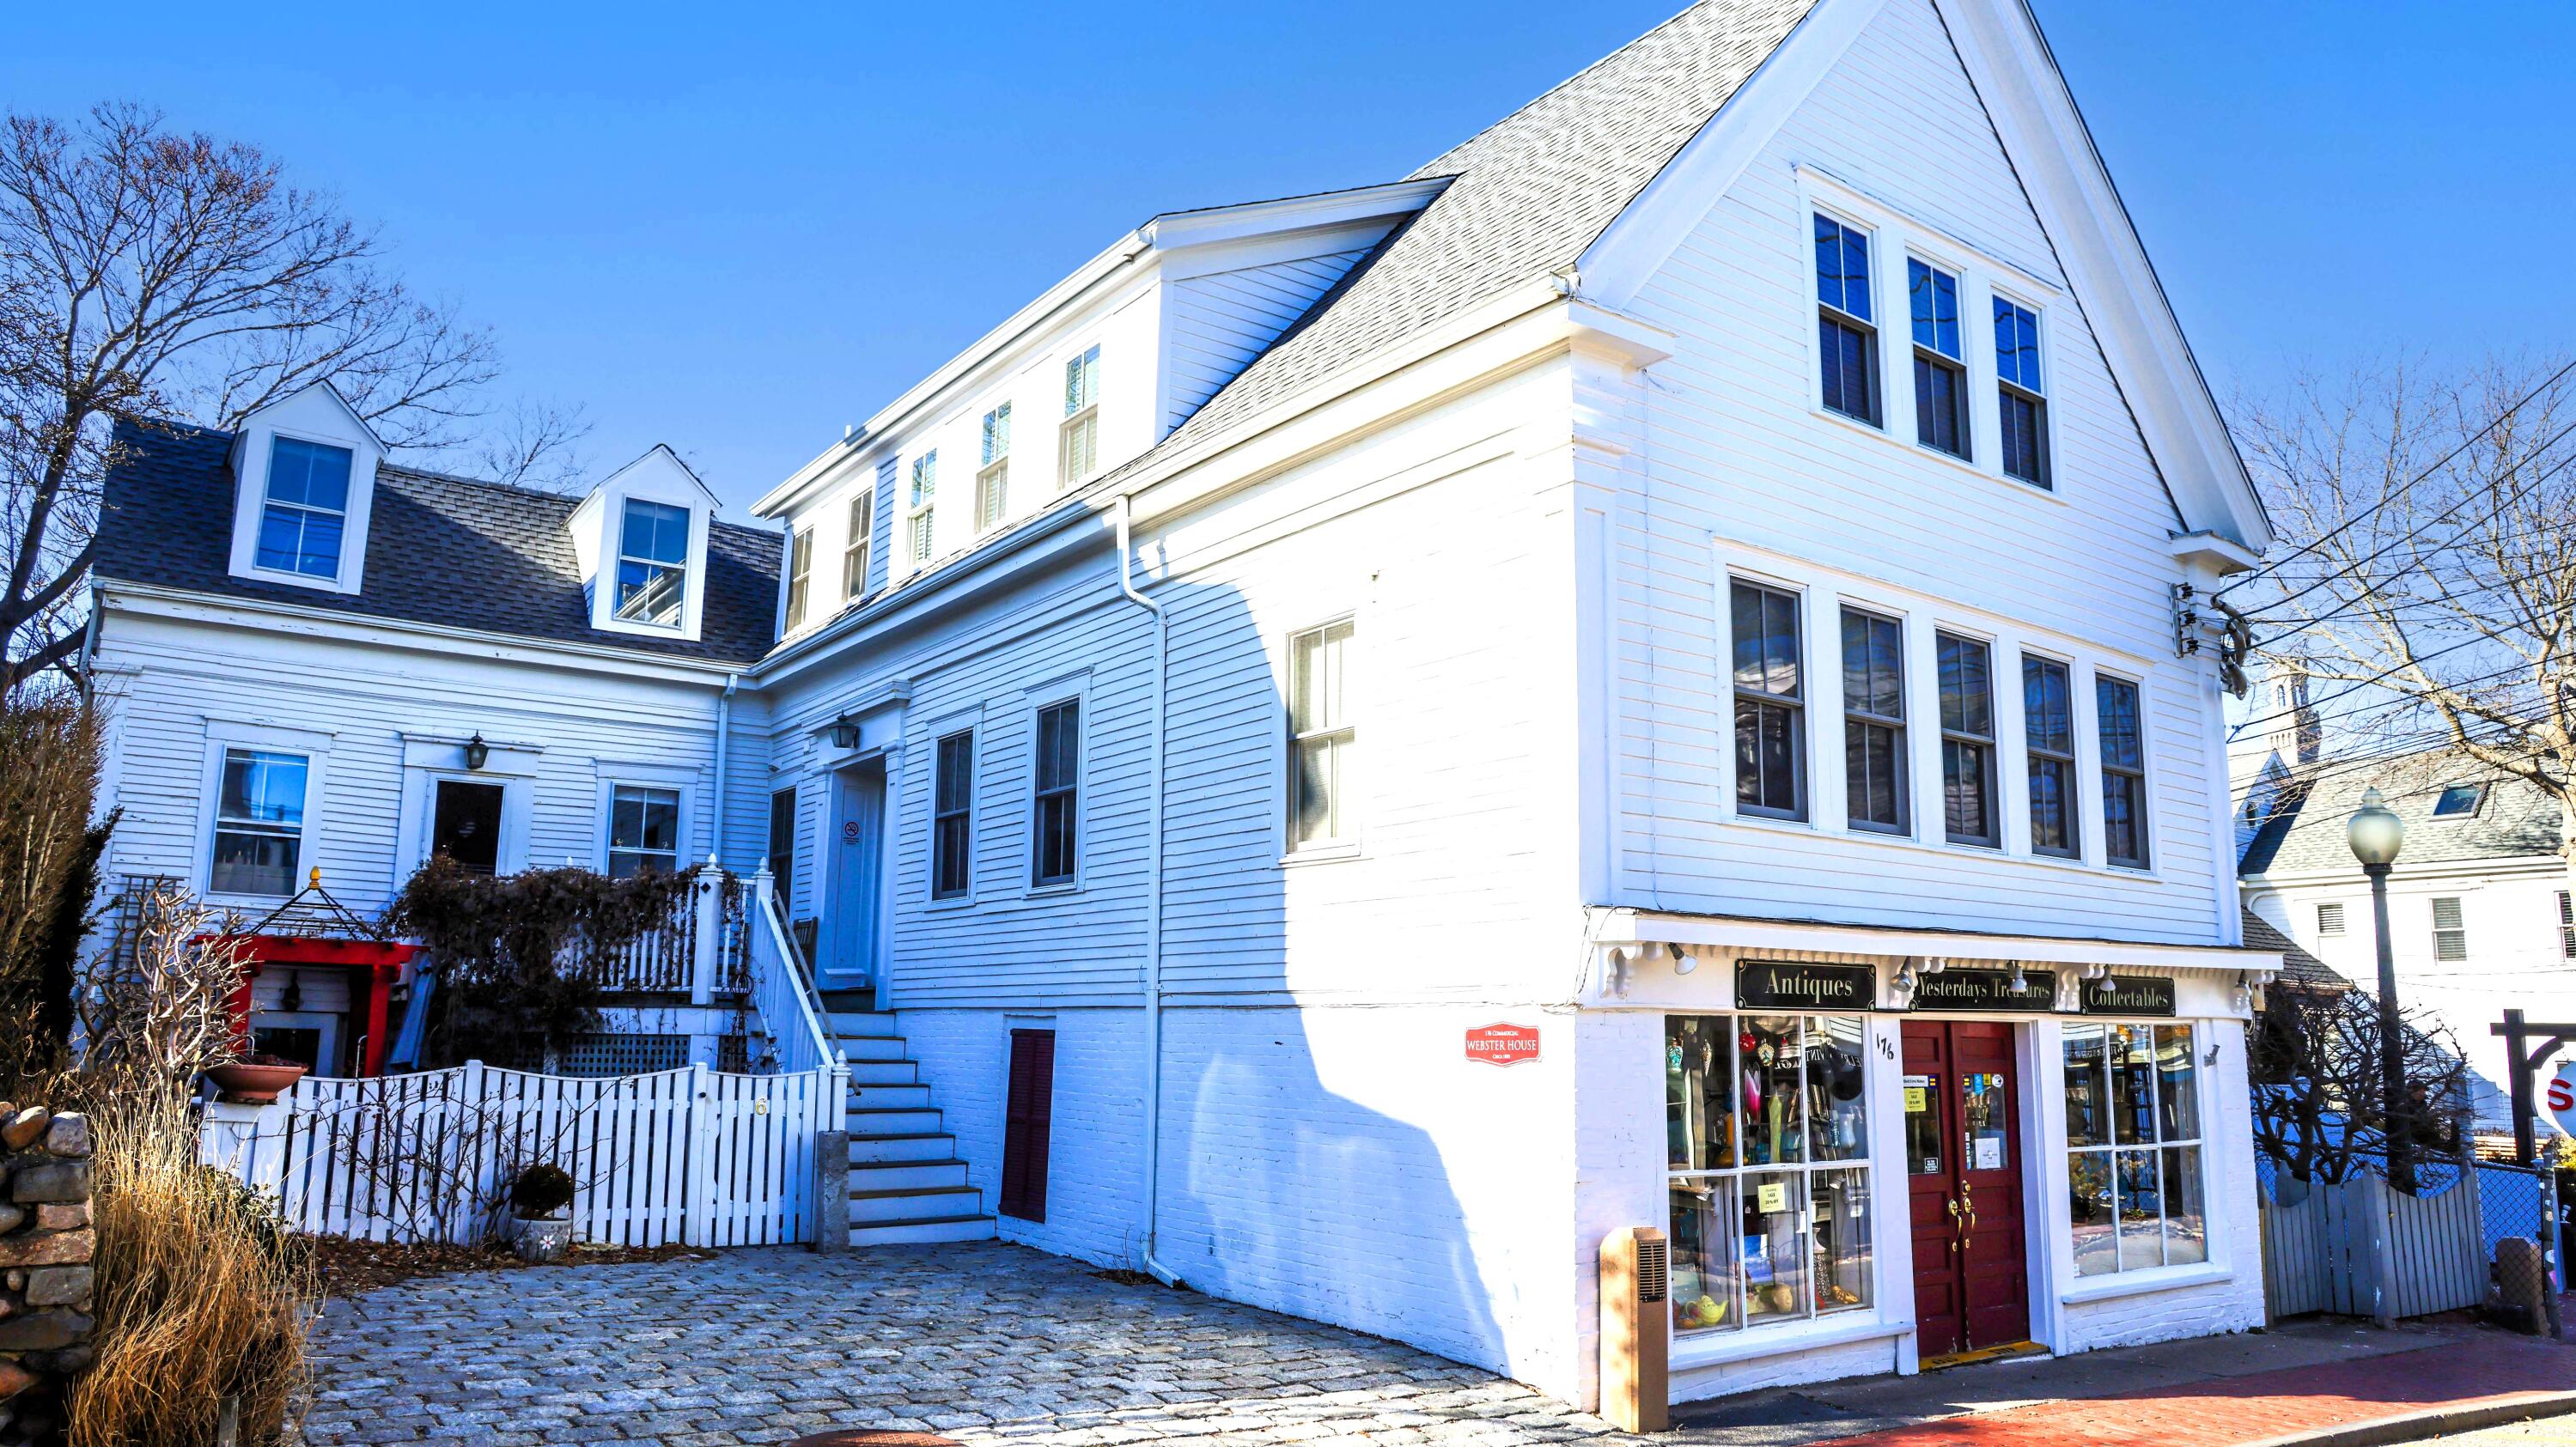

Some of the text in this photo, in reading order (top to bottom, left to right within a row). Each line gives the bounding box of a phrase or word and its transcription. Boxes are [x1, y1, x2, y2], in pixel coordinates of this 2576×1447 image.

[1765, 969, 1853, 1003] Antiques
[1919, 976, 1987, 997] Yesterdays
[2090, 985, 2168, 1008] Collectables
[1466, 1039, 1537, 1051] WEBSTER HOUSE
[1876, 1032, 1895, 1061] 176
[755, 1097, 767, 1116] 6
